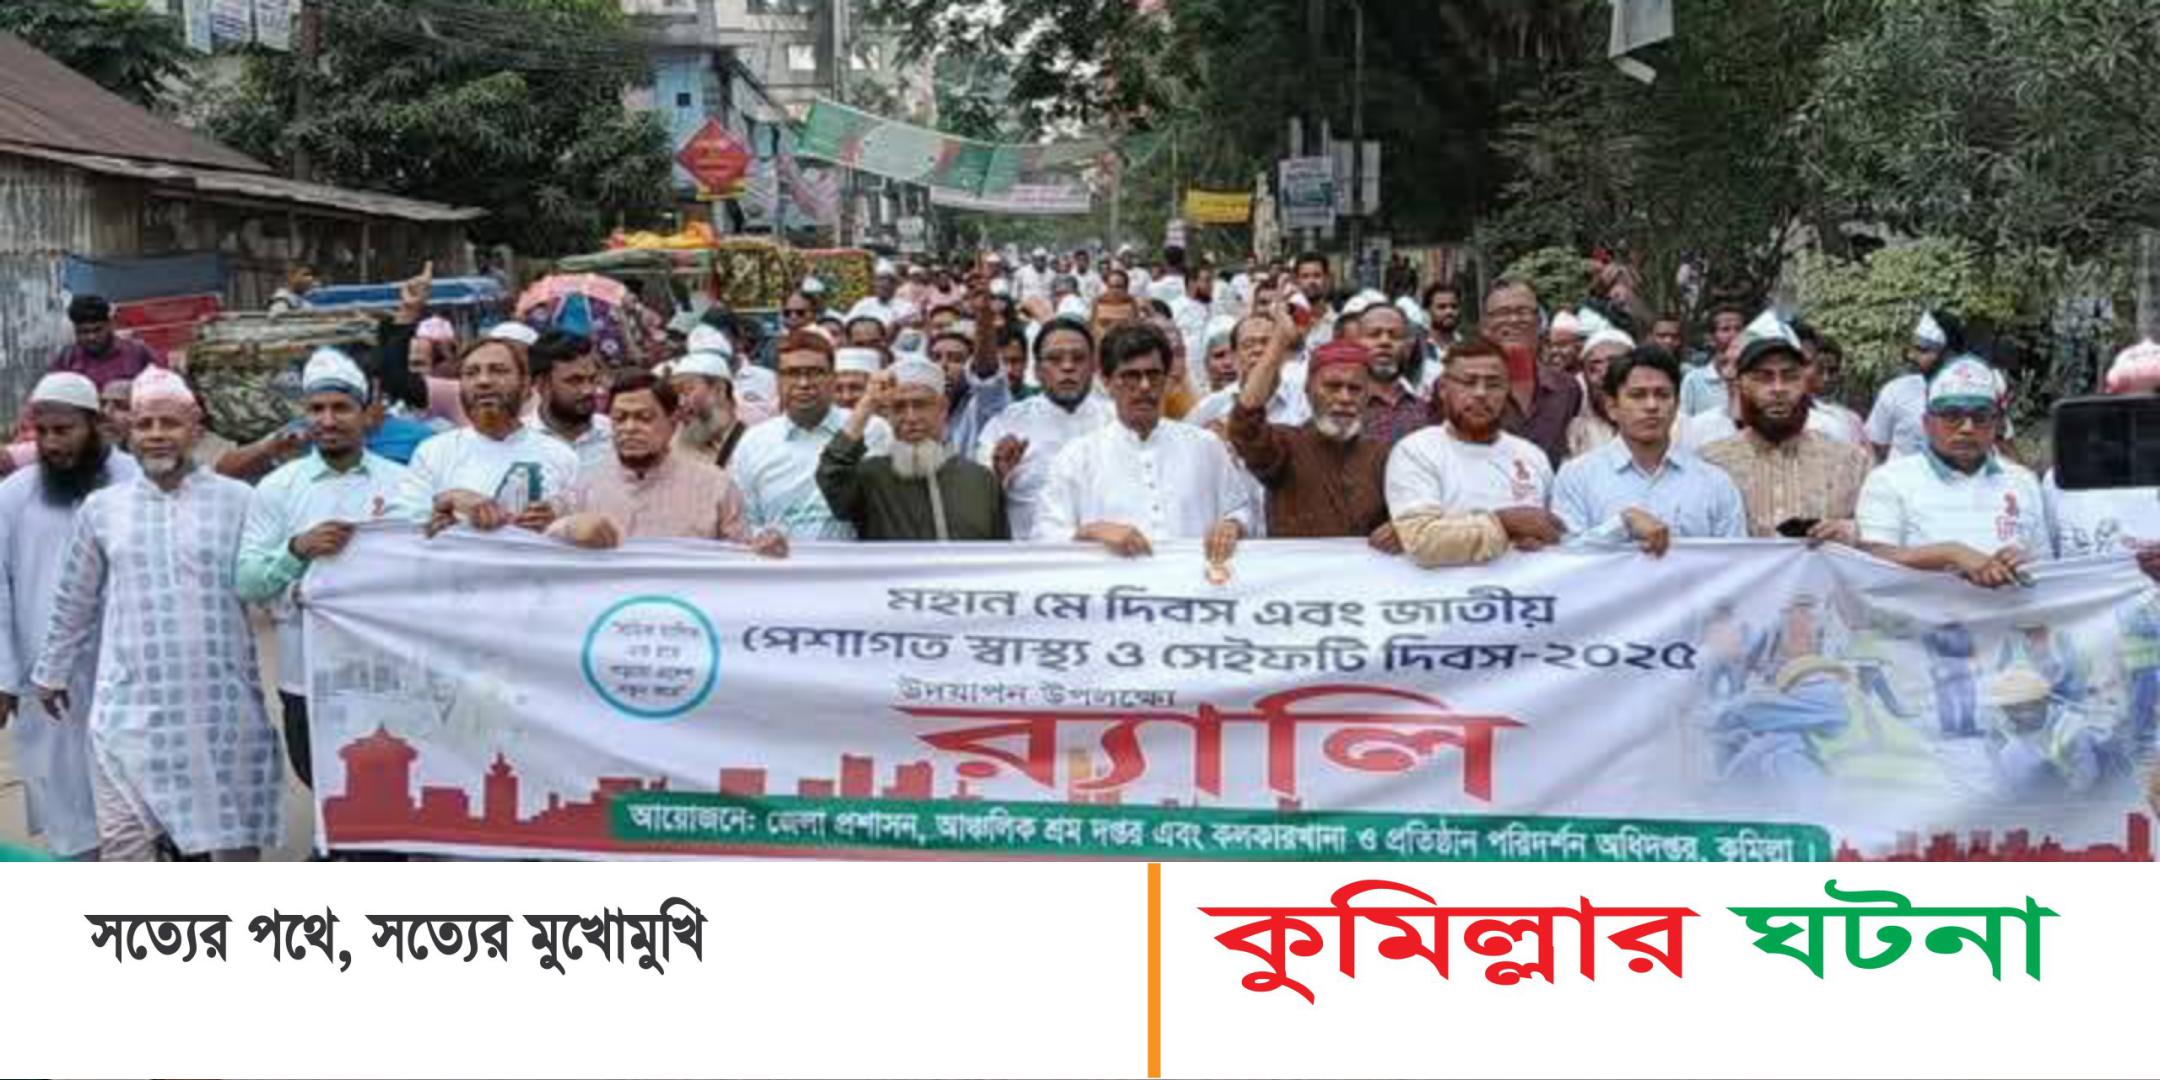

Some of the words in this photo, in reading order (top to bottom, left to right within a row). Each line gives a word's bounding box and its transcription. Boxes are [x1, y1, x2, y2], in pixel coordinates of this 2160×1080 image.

[887, 587, 1019, 616] মহান
[1033, 592, 1091, 621] মে
[1104, 584, 1239, 625] দিবস
[1253, 599, 1366, 627] এবং
[1378, 584, 1558, 628] জাতীয়
[741, 624, 954, 661] পেশাগত
[963, 634, 1092, 671] স্বাস্থ্য
[1106, 640, 1145, 668] ও
[1161, 634, 1369, 673] সেইফটি
[1384, 633, 1699, 672] দিবস-২০২৫
[766, 808, 827, 837] জেলা
[834, 810, 927, 845] প্রশাসন,
[935, 806, 1036, 843] আঞ্চলিক
[1043, 816, 1082, 845] শ্রম
[1090, 817, 1145, 848] দপ্তর
[1152, 820, 1204, 851] এবং
[1211, 821, 1347, 852] কলকারখানা
[1355, 826, 1377, 851] ও
[1385, 818, 1478, 857] প্রতিষ্ঠান
[1487, 821, 1586, 859] পরিদর্শন
[1714, 827, 1794, 862] কমিল্লা
